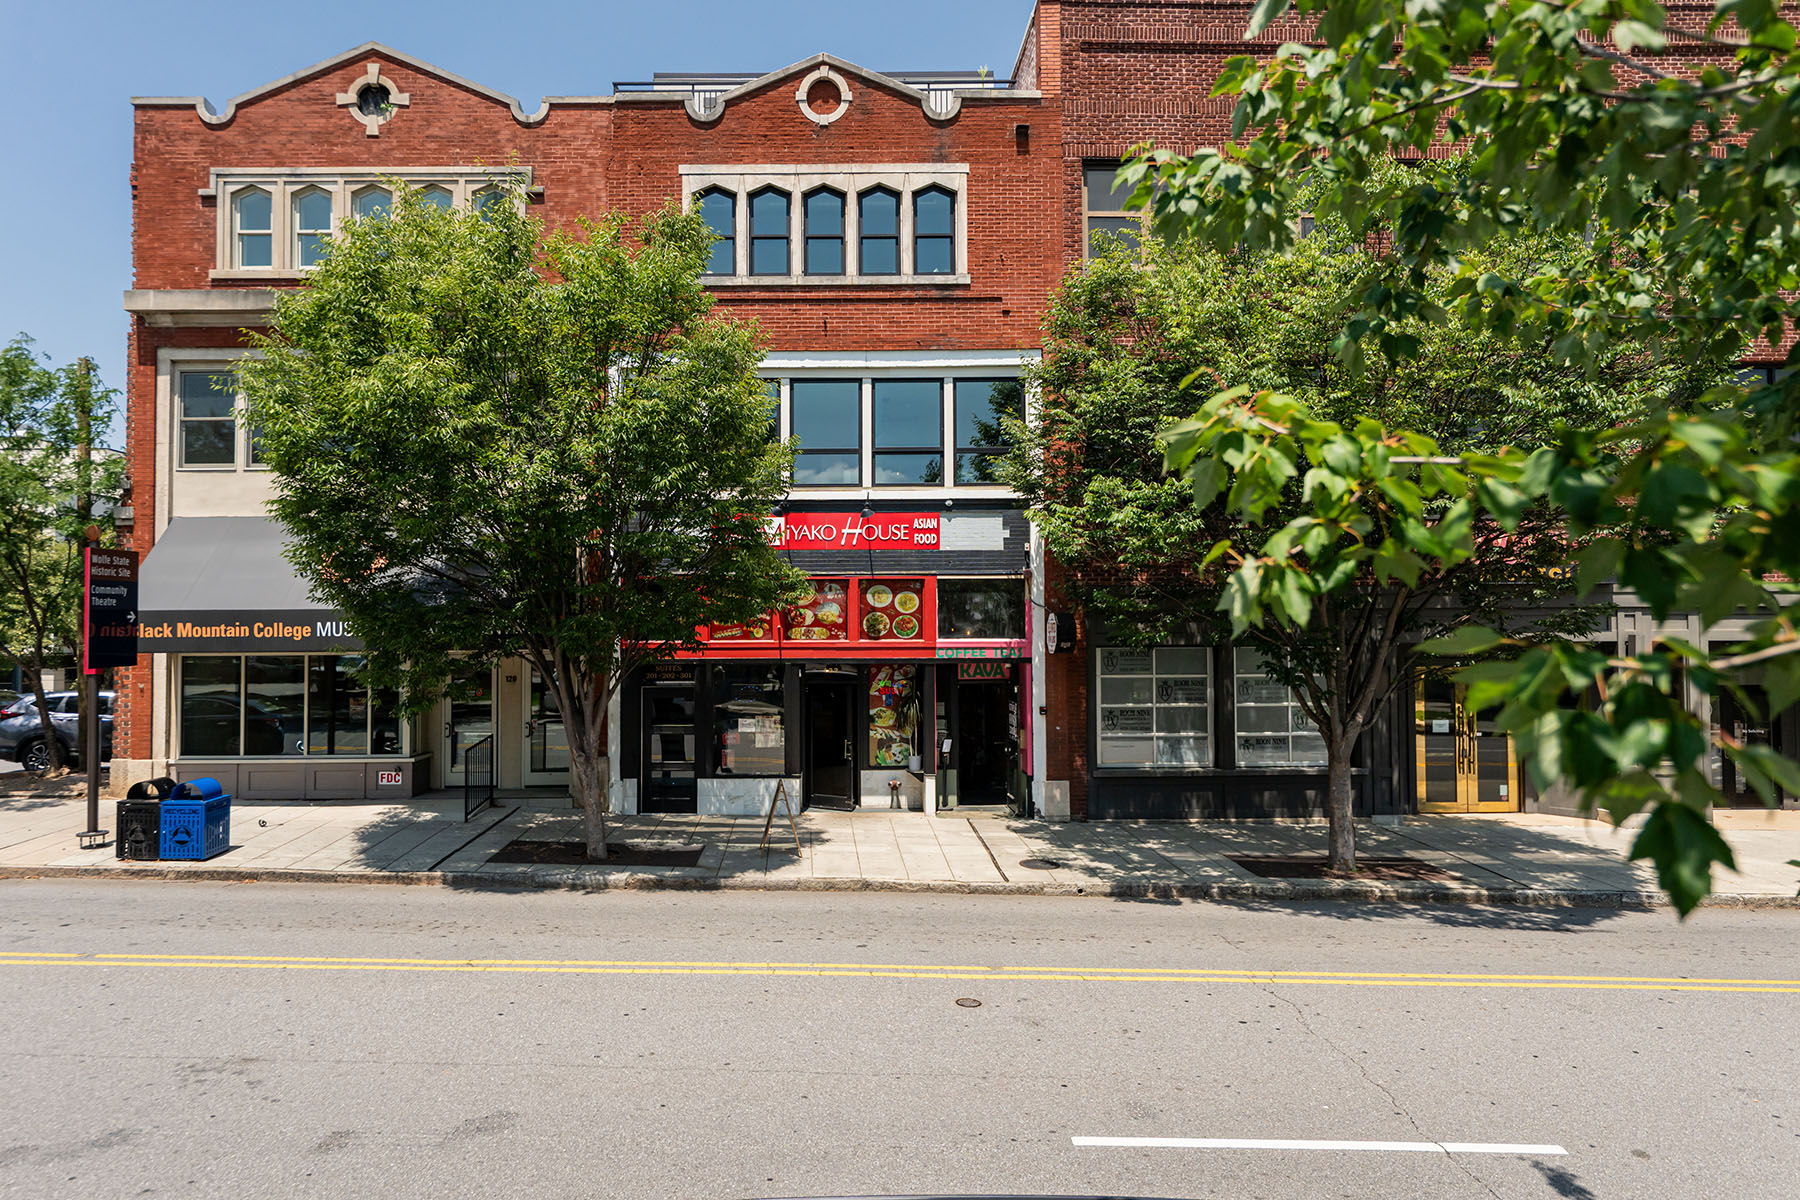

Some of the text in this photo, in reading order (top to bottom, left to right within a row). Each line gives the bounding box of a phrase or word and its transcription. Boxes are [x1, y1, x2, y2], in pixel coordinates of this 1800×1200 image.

[913, 518, 938, 530] ASIAN
[841, 516, 909, 546] HOUSE
[914, 533, 938, 545] FOOD
[91, 554, 130, 566] Wolfe State
[91, 565, 131, 577] Historic Site
[91, 584, 128, 598] Community
[91, 596, 117, 607] Theatre
[137, 622, 173, 637] lack
[176, 621, 250, 638] Mountain
[253, 621, 312, 641] College
[936, 647, 1023, 659] COFFEE TEAS
[655, 664, 683, 673] SUITES
[960, 663, 1006, 678] KAVA
[380, 772, 401, 784] FDC
